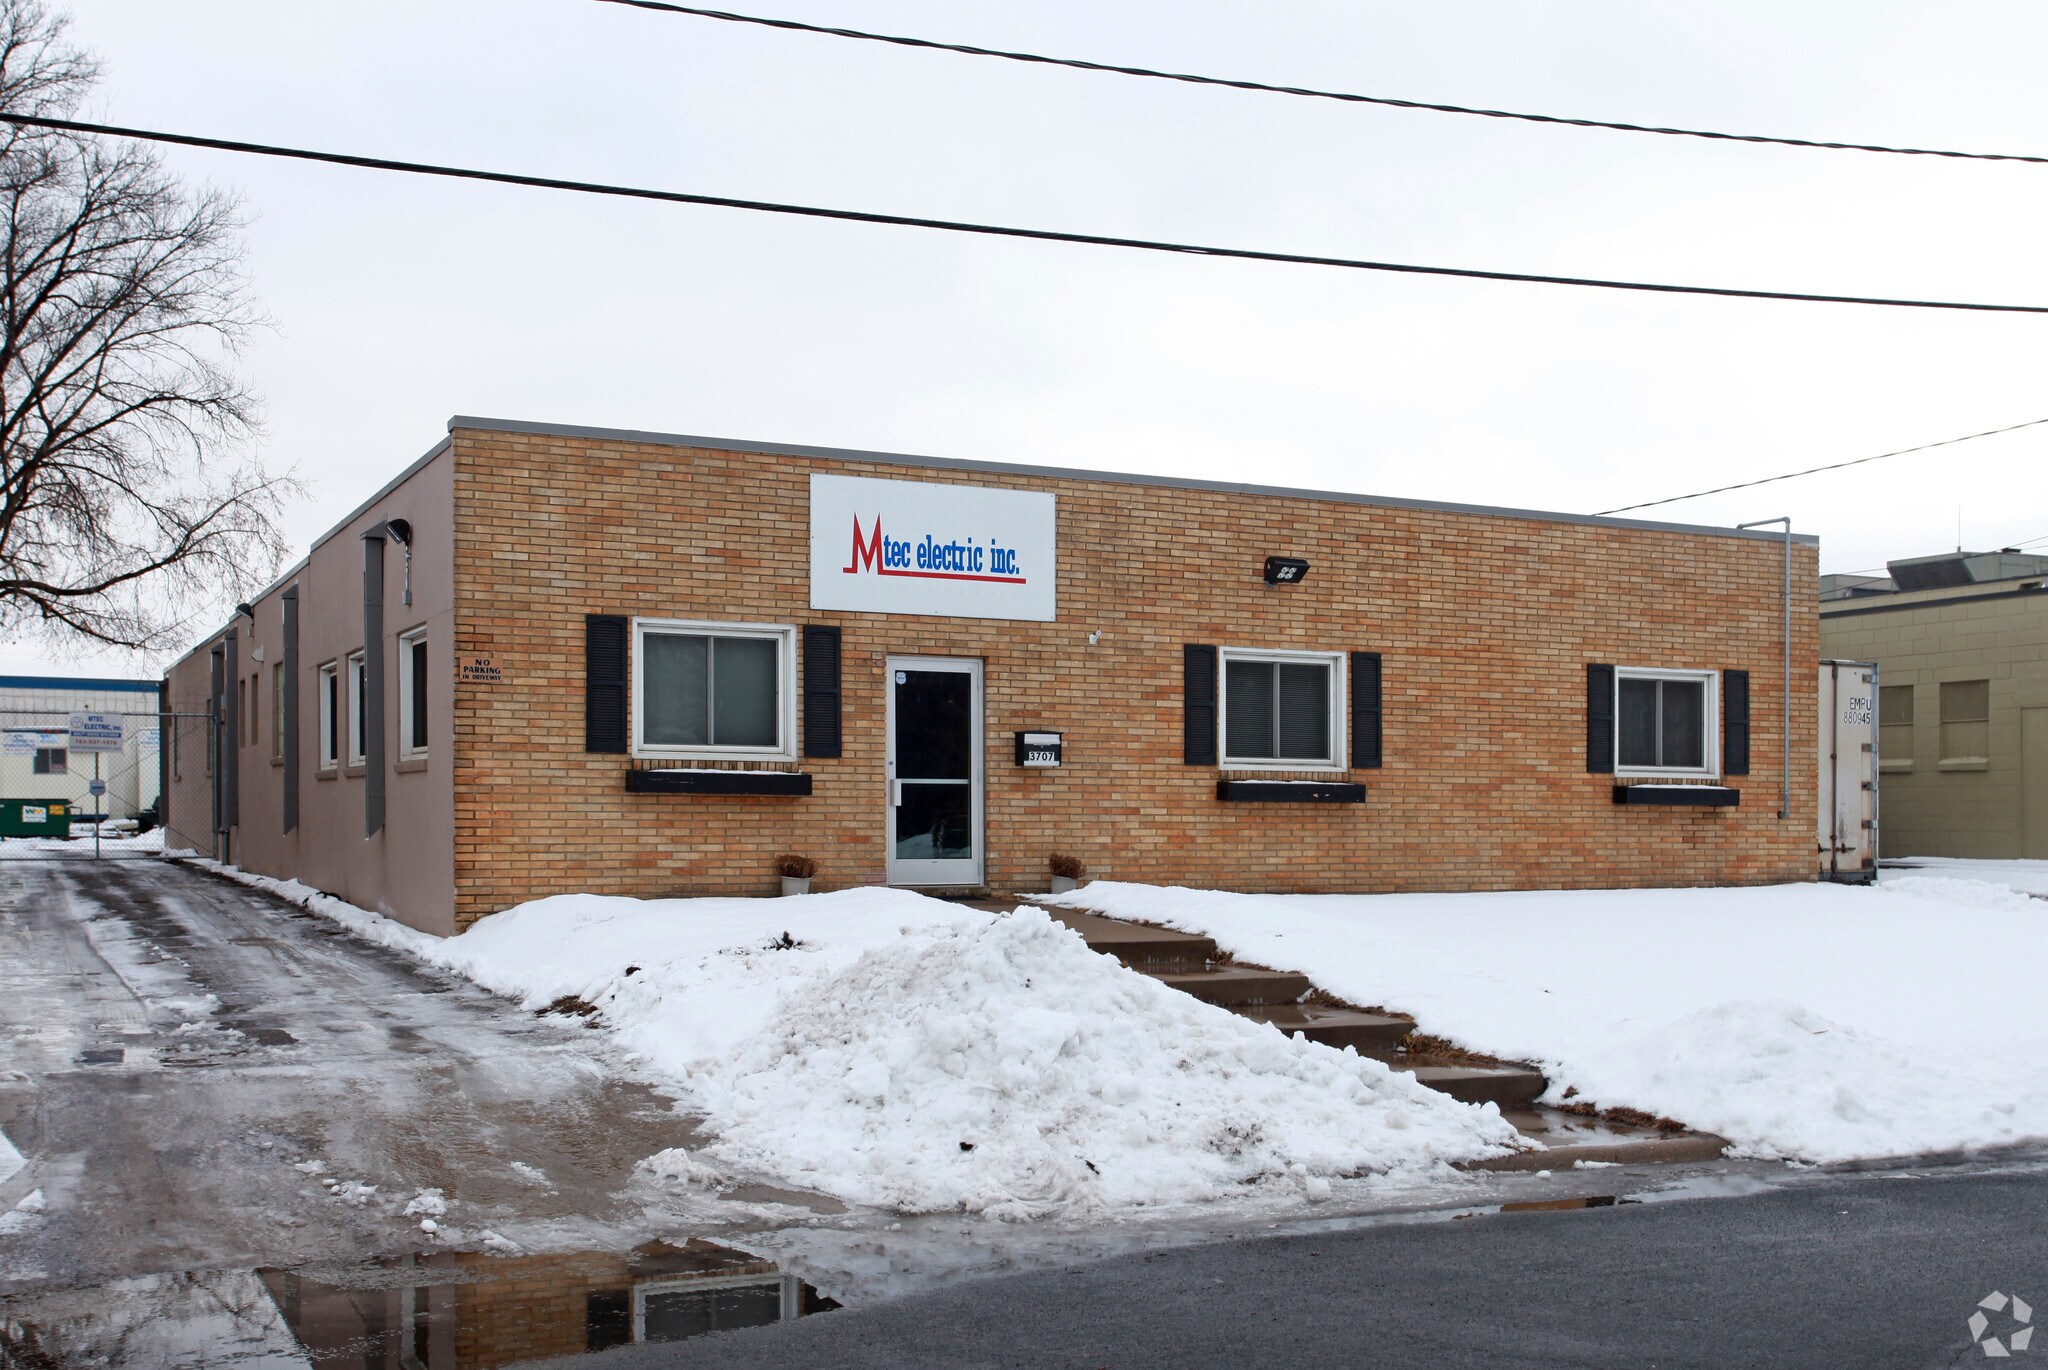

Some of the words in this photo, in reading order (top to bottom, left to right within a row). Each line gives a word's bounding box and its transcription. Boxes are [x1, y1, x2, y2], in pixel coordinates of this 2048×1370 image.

[843, 511, 911, 576] Mtec
[917, 534, 983, 572] electric
[990, 538, 1020, 575] inc.
[475, 658, 490, 666] NO
[464, 666, 501, 674] PARKING
[1849, 697, 1872, 711] EMPU
[1843, 711, 1871, 725] 880945
[1029, 752, 1054, 761] 3707
